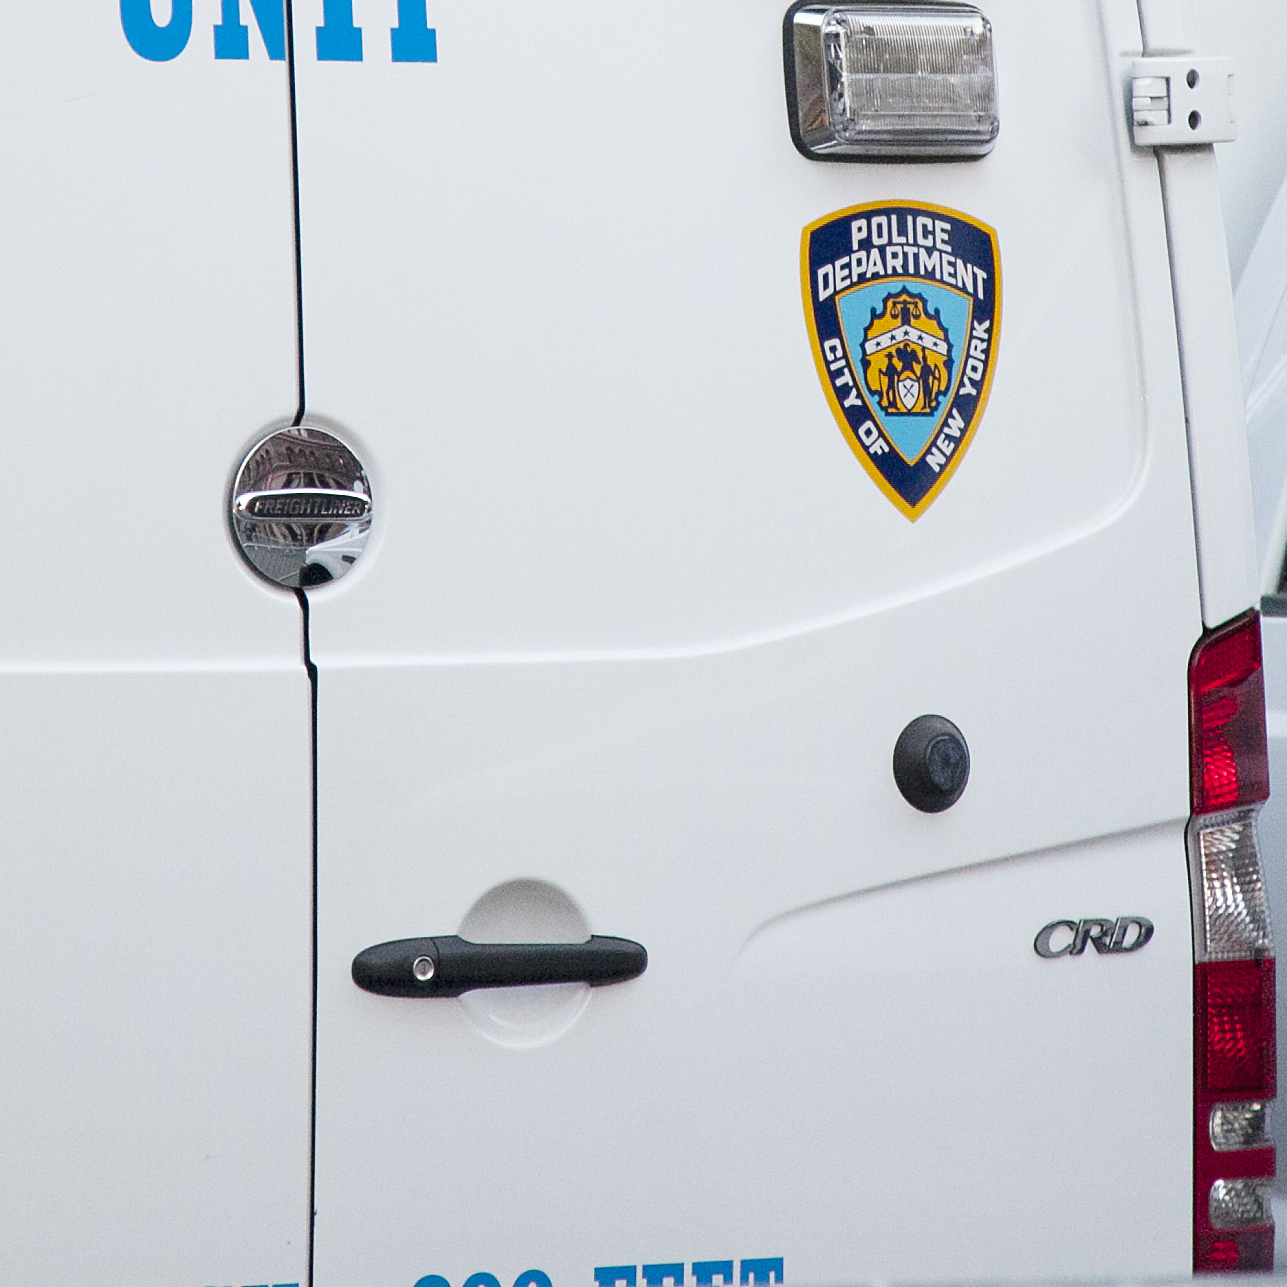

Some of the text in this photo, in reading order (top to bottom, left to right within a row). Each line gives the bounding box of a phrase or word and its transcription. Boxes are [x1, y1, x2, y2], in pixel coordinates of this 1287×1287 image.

[851, 214, 953, 253] POLICE
[817, 245, 988, 302] DEPARTMENT
[824, 319, 991, 473] CITY OF NEW YORK
[254, 499, 362, 515] FREIGHTLINER
[1033, 916, 1155, 959] CRD
